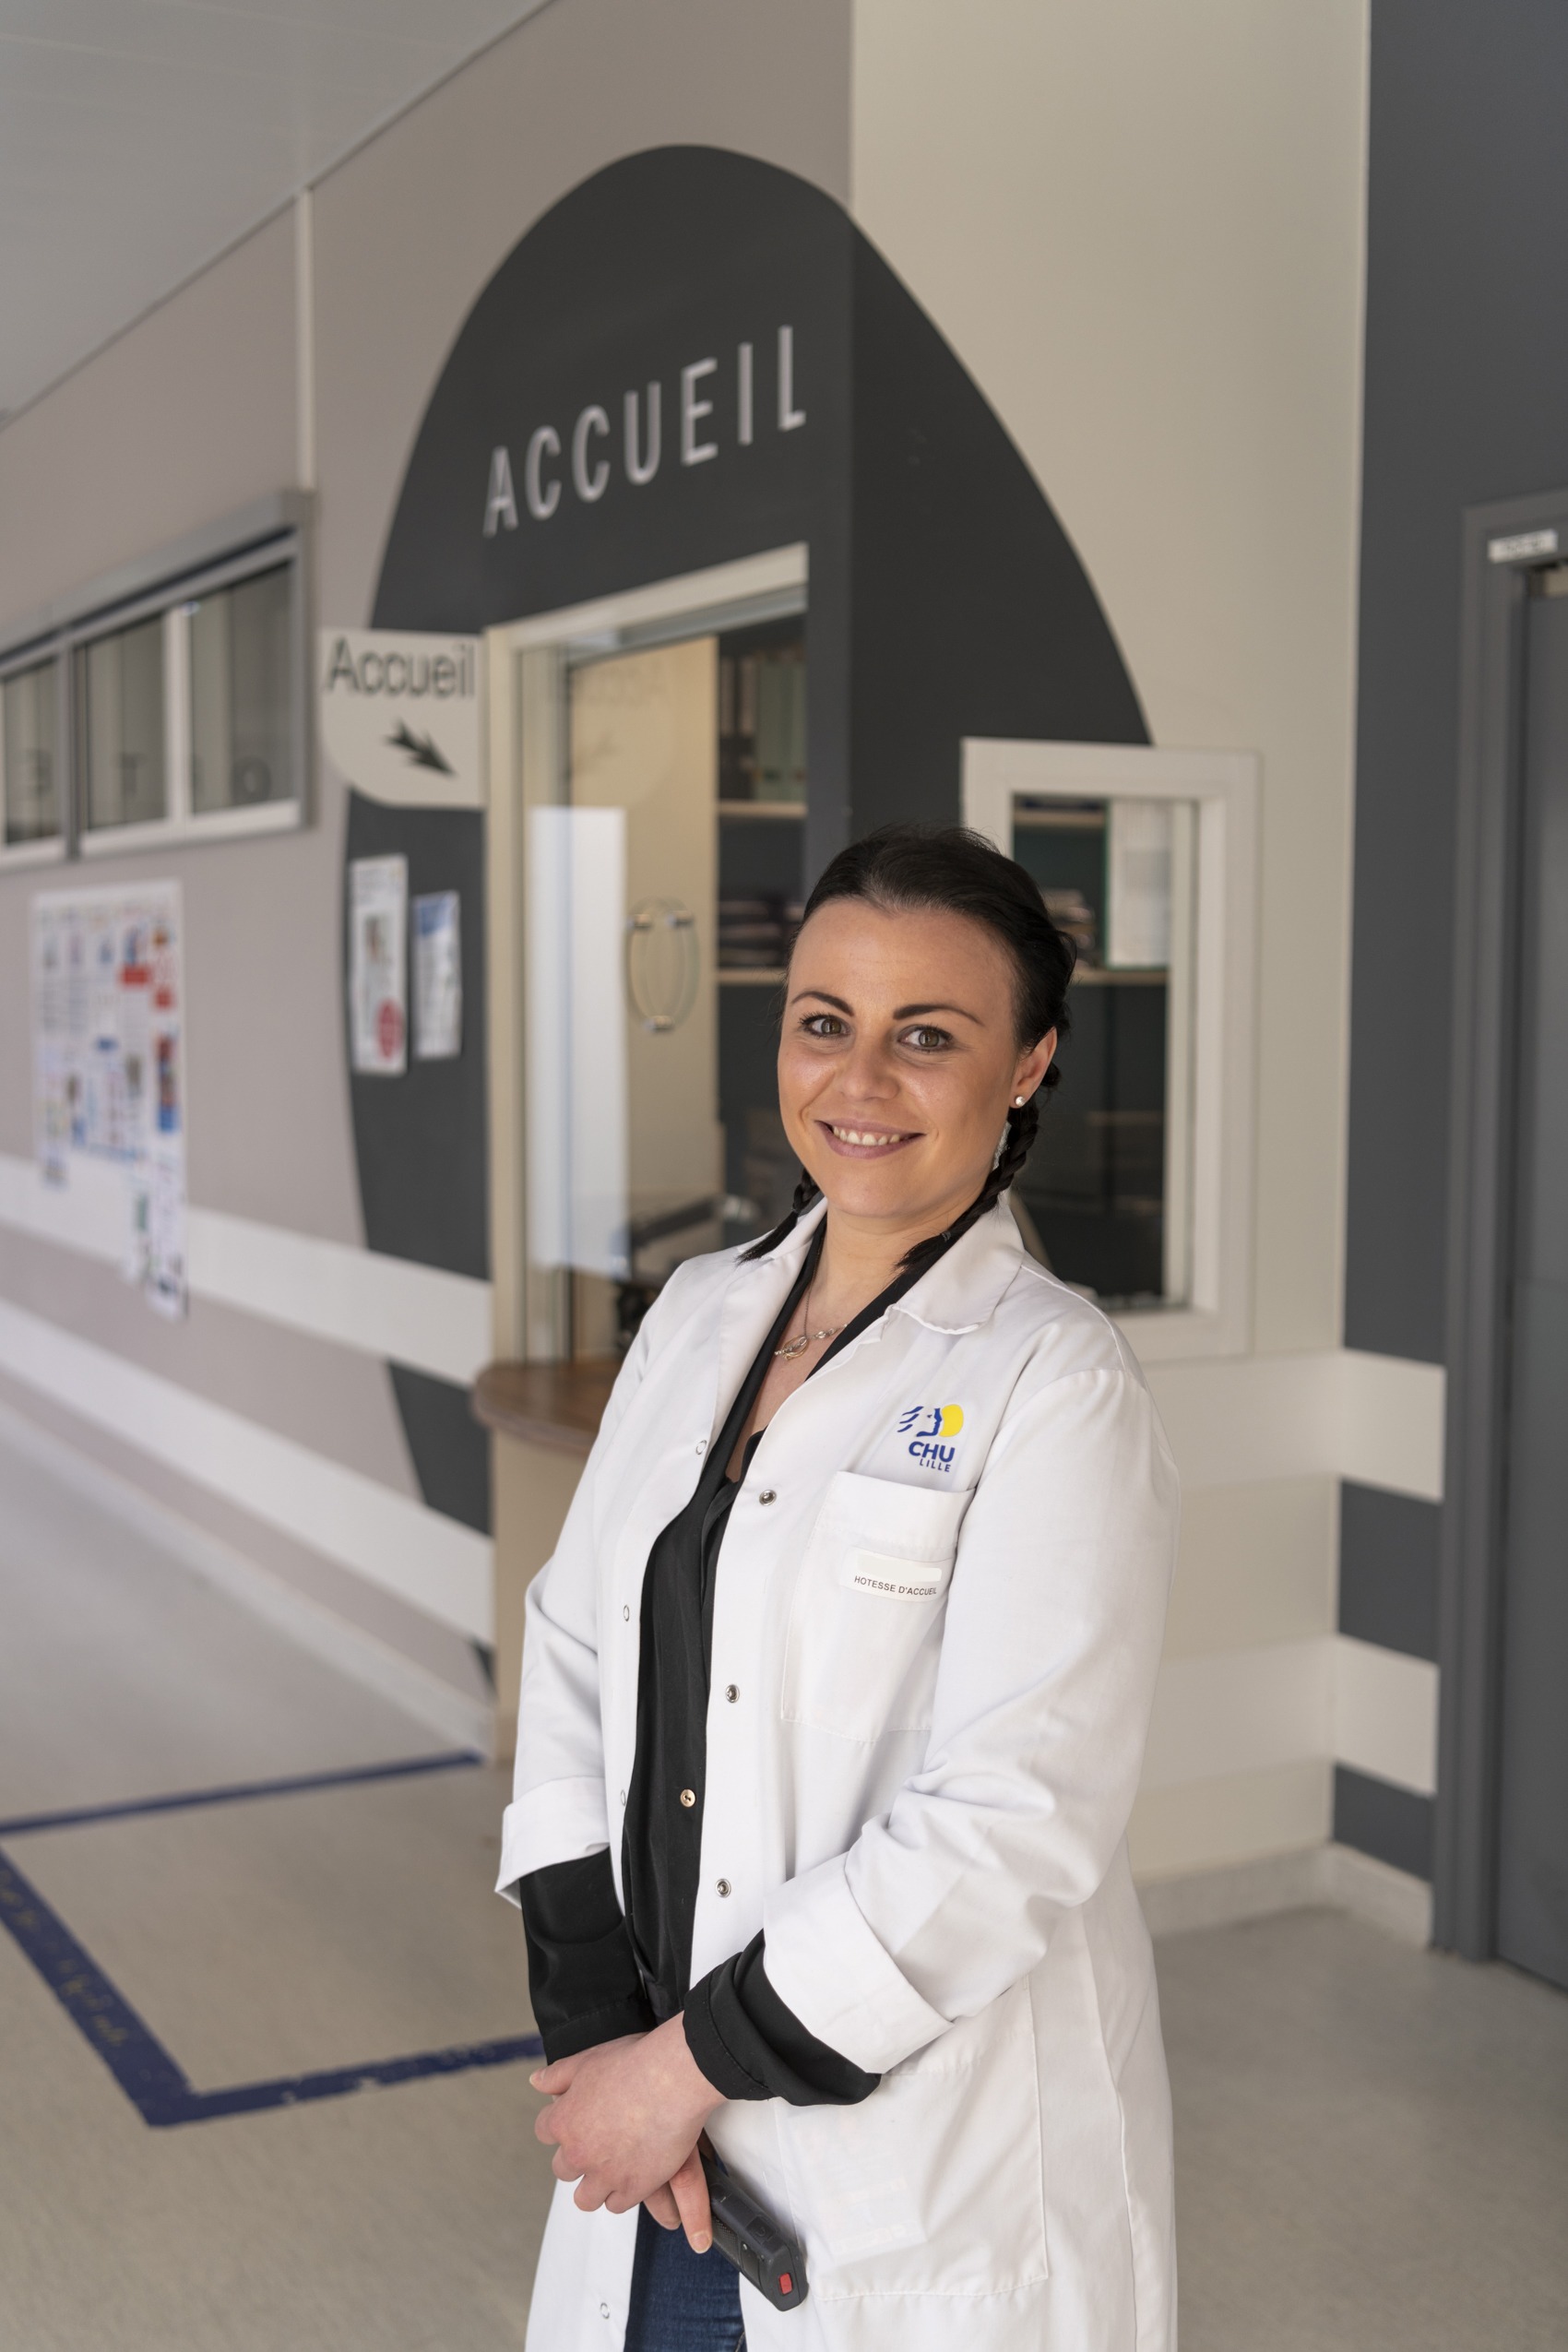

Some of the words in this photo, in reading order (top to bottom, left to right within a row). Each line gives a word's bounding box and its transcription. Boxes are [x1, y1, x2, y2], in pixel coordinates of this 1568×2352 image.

[482, 325, 807, 538] ACCUEIL
[326, 636, 476, 698] Accueil
[909, 1441, 955, 1462] CHU
[920, 1459, 951, 1472] LILLE
[854, 1575, 896, 1592] HOTESSE
[898, 1586, 937, 1596] D'ACCUEIL
